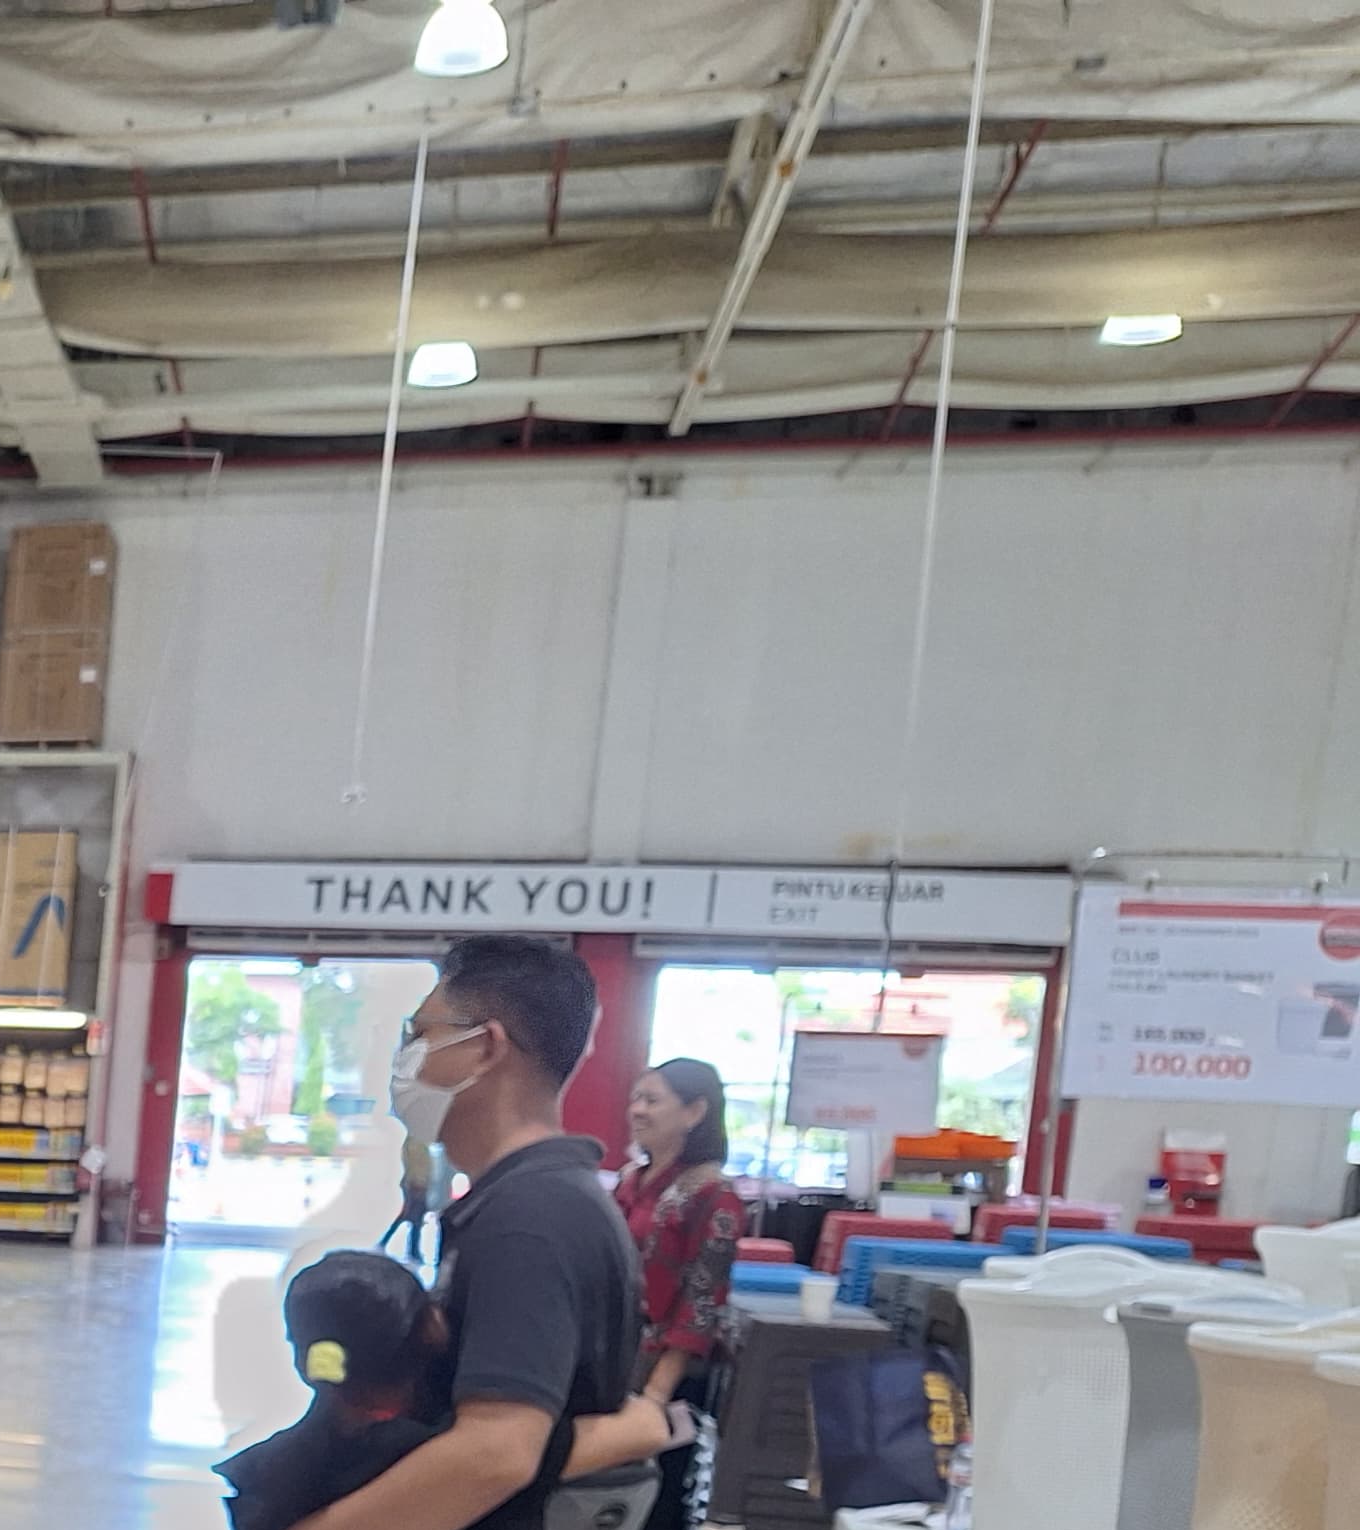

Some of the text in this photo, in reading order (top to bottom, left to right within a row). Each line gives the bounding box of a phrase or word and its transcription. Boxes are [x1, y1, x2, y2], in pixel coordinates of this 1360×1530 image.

[306, 877, 654, 919] THANK YOU!
[773, 878, 844, 901] PINTU
[1136, 1051, 1251, 1079] 100.000
